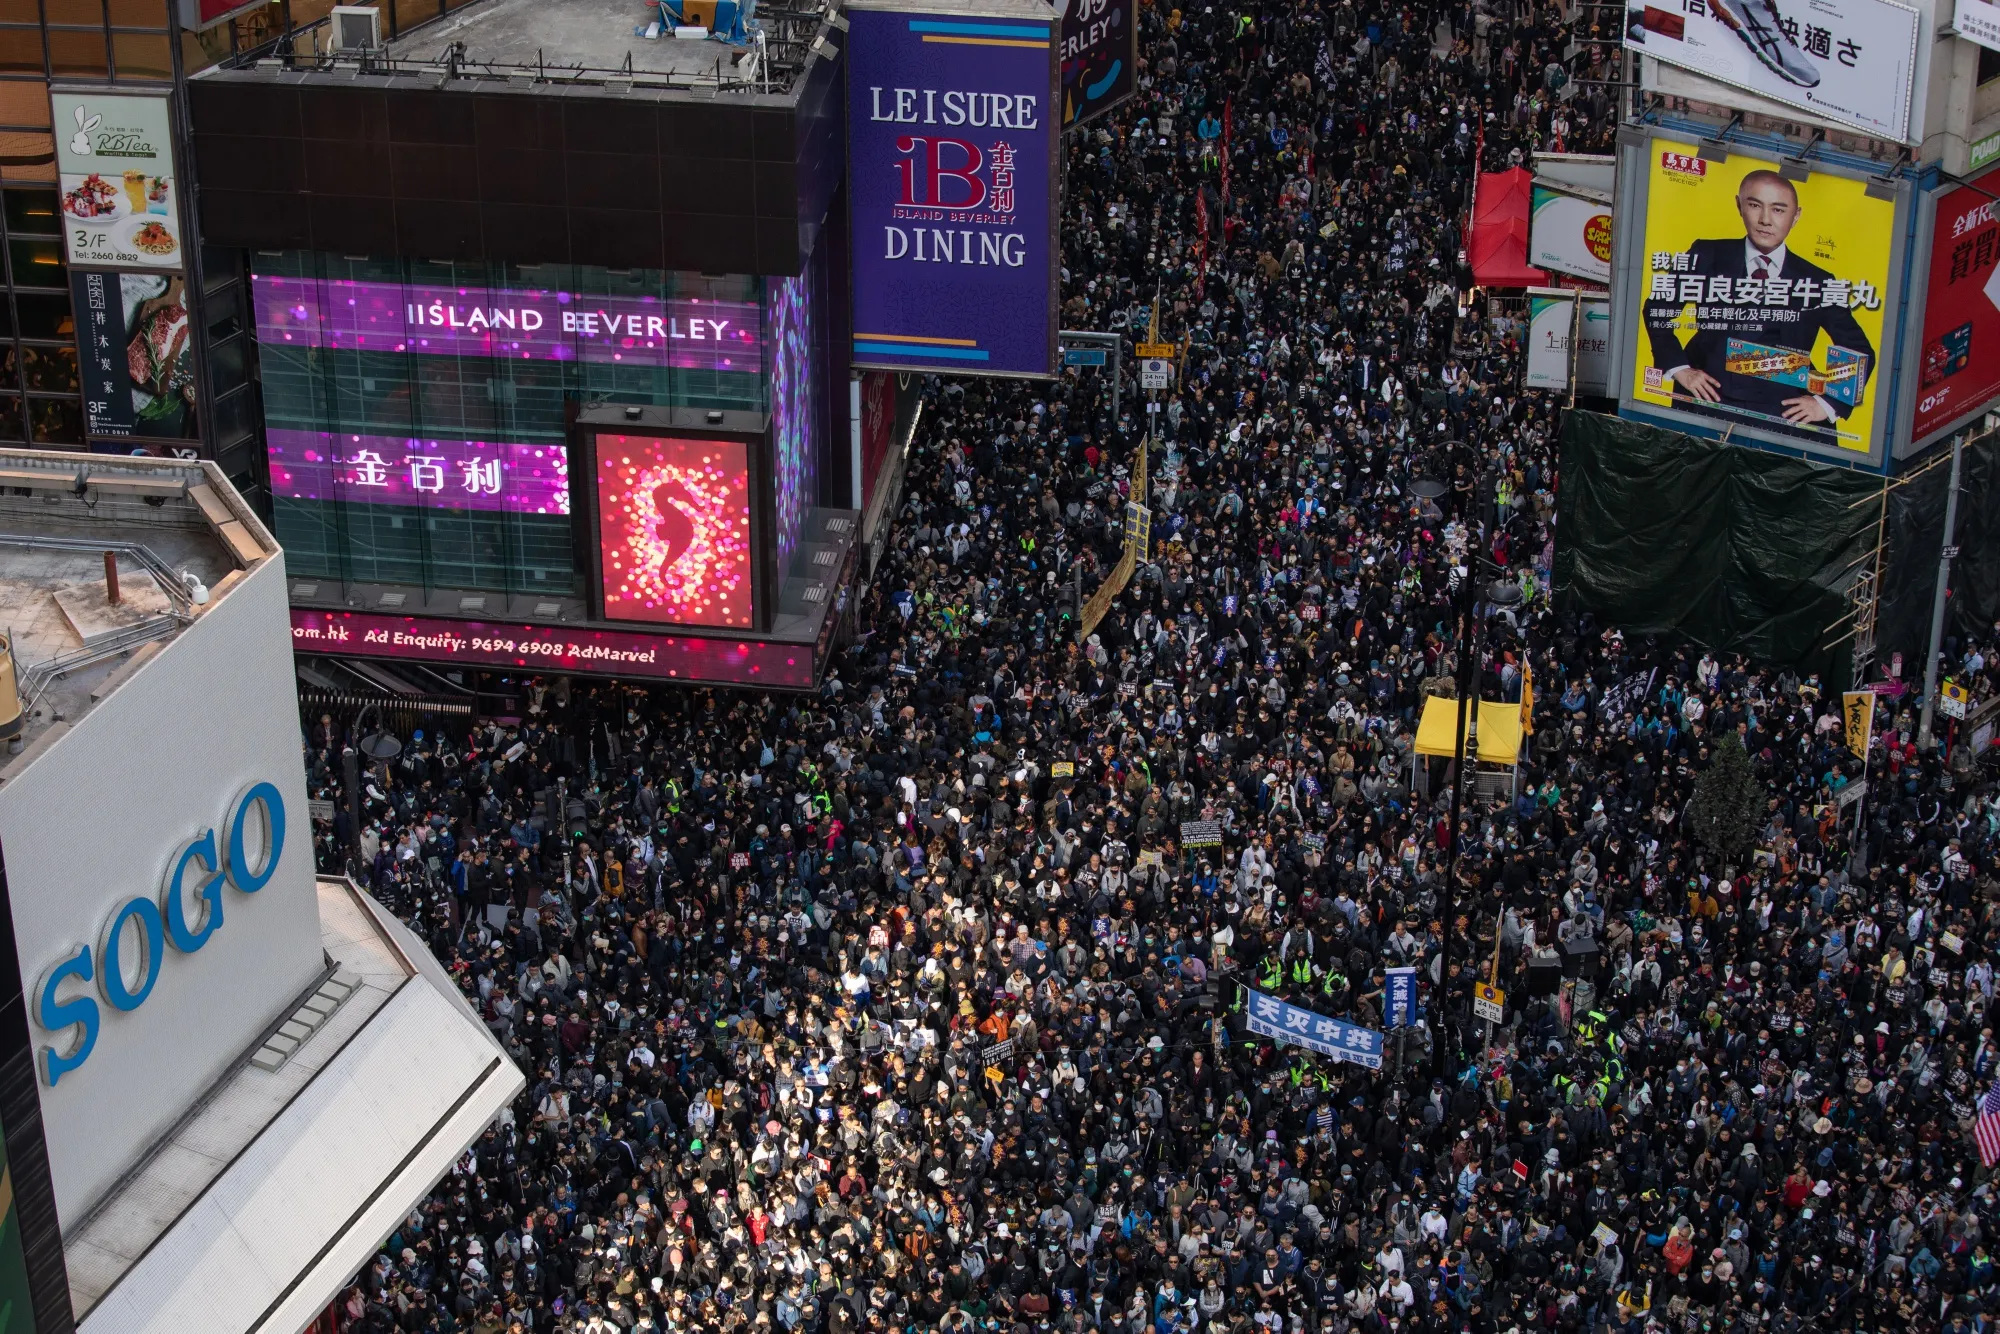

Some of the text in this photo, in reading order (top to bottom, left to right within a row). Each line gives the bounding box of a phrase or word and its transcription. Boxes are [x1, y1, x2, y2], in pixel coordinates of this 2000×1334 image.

[870, 87, 1038, 129] LEISURE
[97, 133, 154, 152] RBTea
[989, 140, 1017, 213] 金百利
[1667, 153, 1701, 171] 馬百良
[892, 208, 1017, 225] ISLAND BEVERLEY
[75, 230, 107, 249] 3/F
[885, 226, 1026, 267] DINING
[74, 251, 139, 262] Tel: 2660 6829
[1651, 251, 1699, 273] 我信!
[1649, 274, 1881, 311] 馬百良安宮牛黃丸
[89, 401, 108, 414] 3F
[345, 449, 502, 495] 金百利
[290, 624, 655, 663] om.hk Ad Enquiry: 9694 6908 AdMarvel
[36, 779, 287, 1091] SOGO
[1477, 1000, 1500, 1012] 24 hrs
[1256, 995, 1374, 1051] 天灭中共
